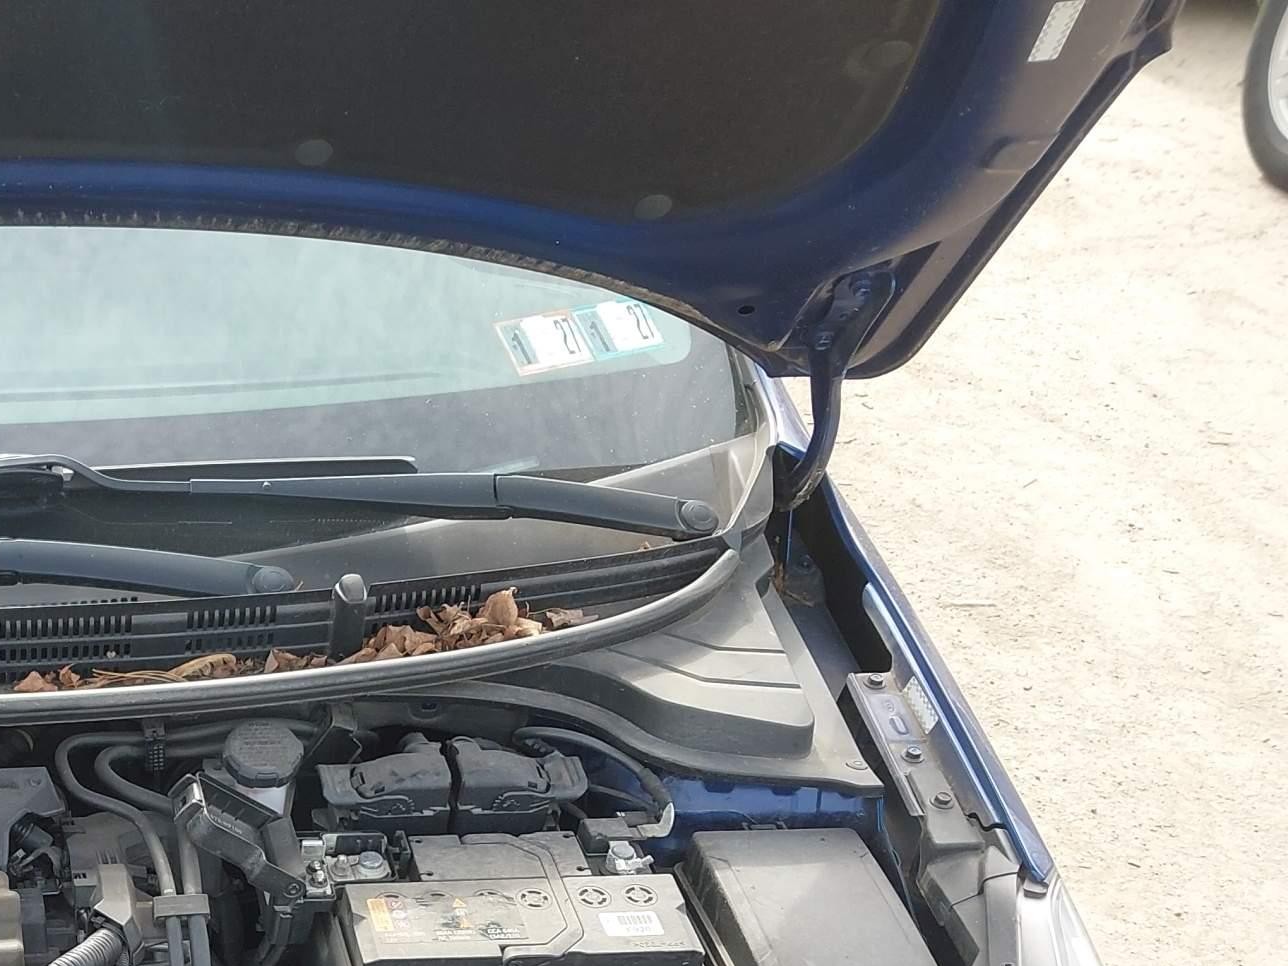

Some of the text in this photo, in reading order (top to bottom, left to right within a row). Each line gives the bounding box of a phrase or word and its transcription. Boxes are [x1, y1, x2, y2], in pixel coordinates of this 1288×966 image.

[511, 317, 582, 364] 1 27
[589, 303, 655, 352] 1 27
